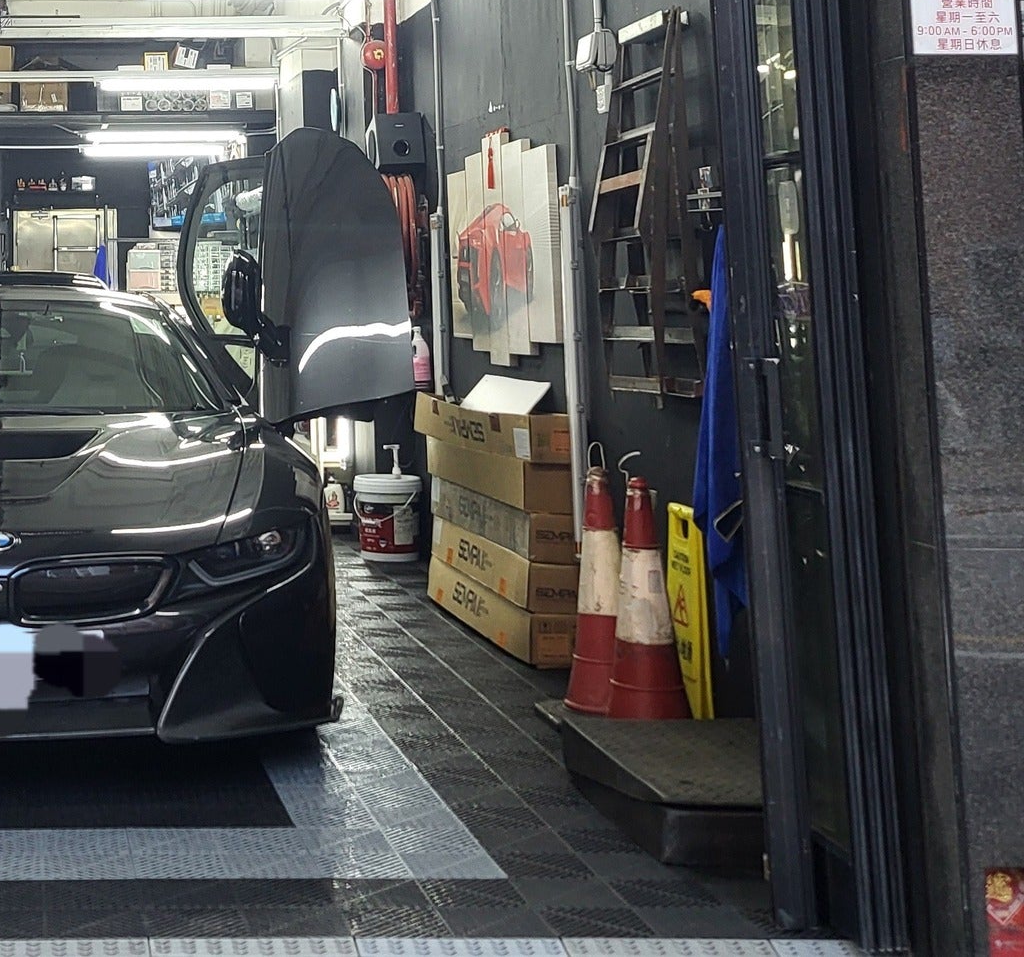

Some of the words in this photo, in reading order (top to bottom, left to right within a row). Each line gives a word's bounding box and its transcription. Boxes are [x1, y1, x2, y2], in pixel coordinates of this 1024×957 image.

[936, 11, 1001, 24] 星期一至六
[937, 38, 1003, 51] 星期日休息
